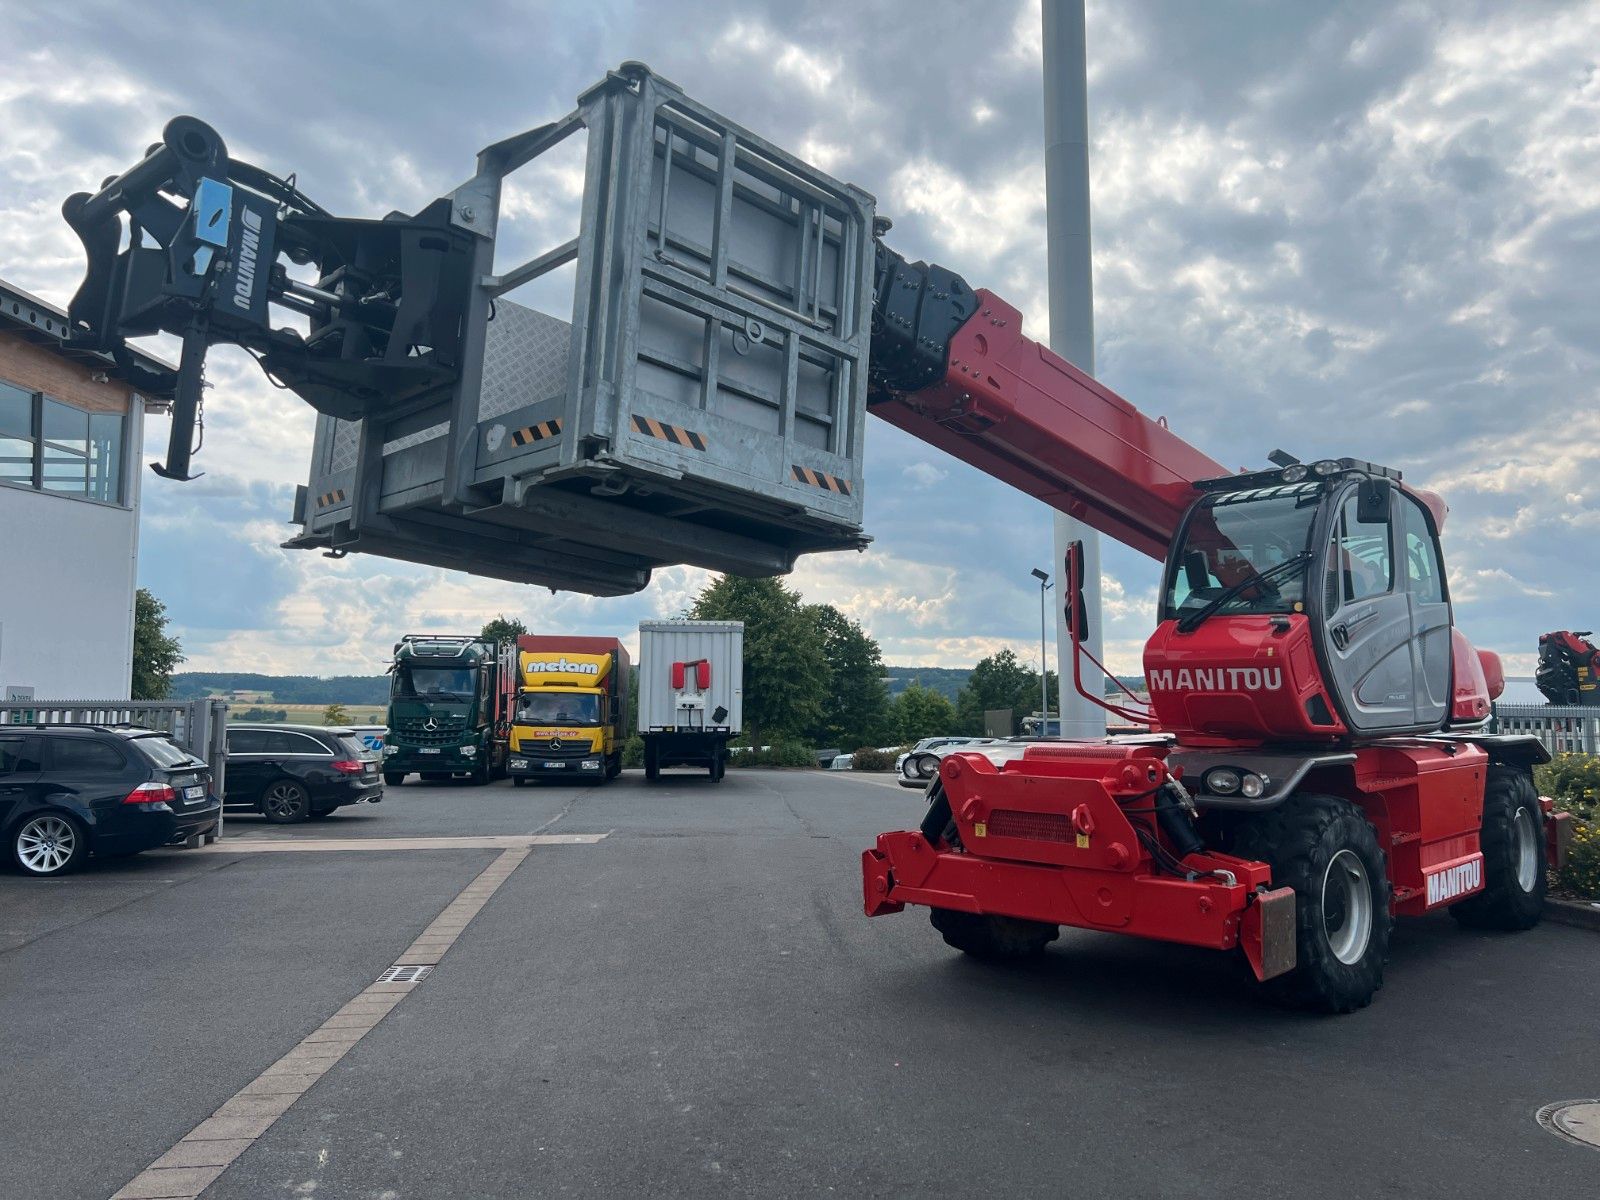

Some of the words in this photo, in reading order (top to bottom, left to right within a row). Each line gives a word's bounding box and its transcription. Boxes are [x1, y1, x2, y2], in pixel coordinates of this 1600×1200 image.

[233, 228, 260, 311] MANITOU
[526, 657, 599, 675] metam
[1149, 667, 1282, 691] MANITOU
[536, 730, 577, 738] www.metam.de
[1427, 859, 1481, 906] MANITOU
